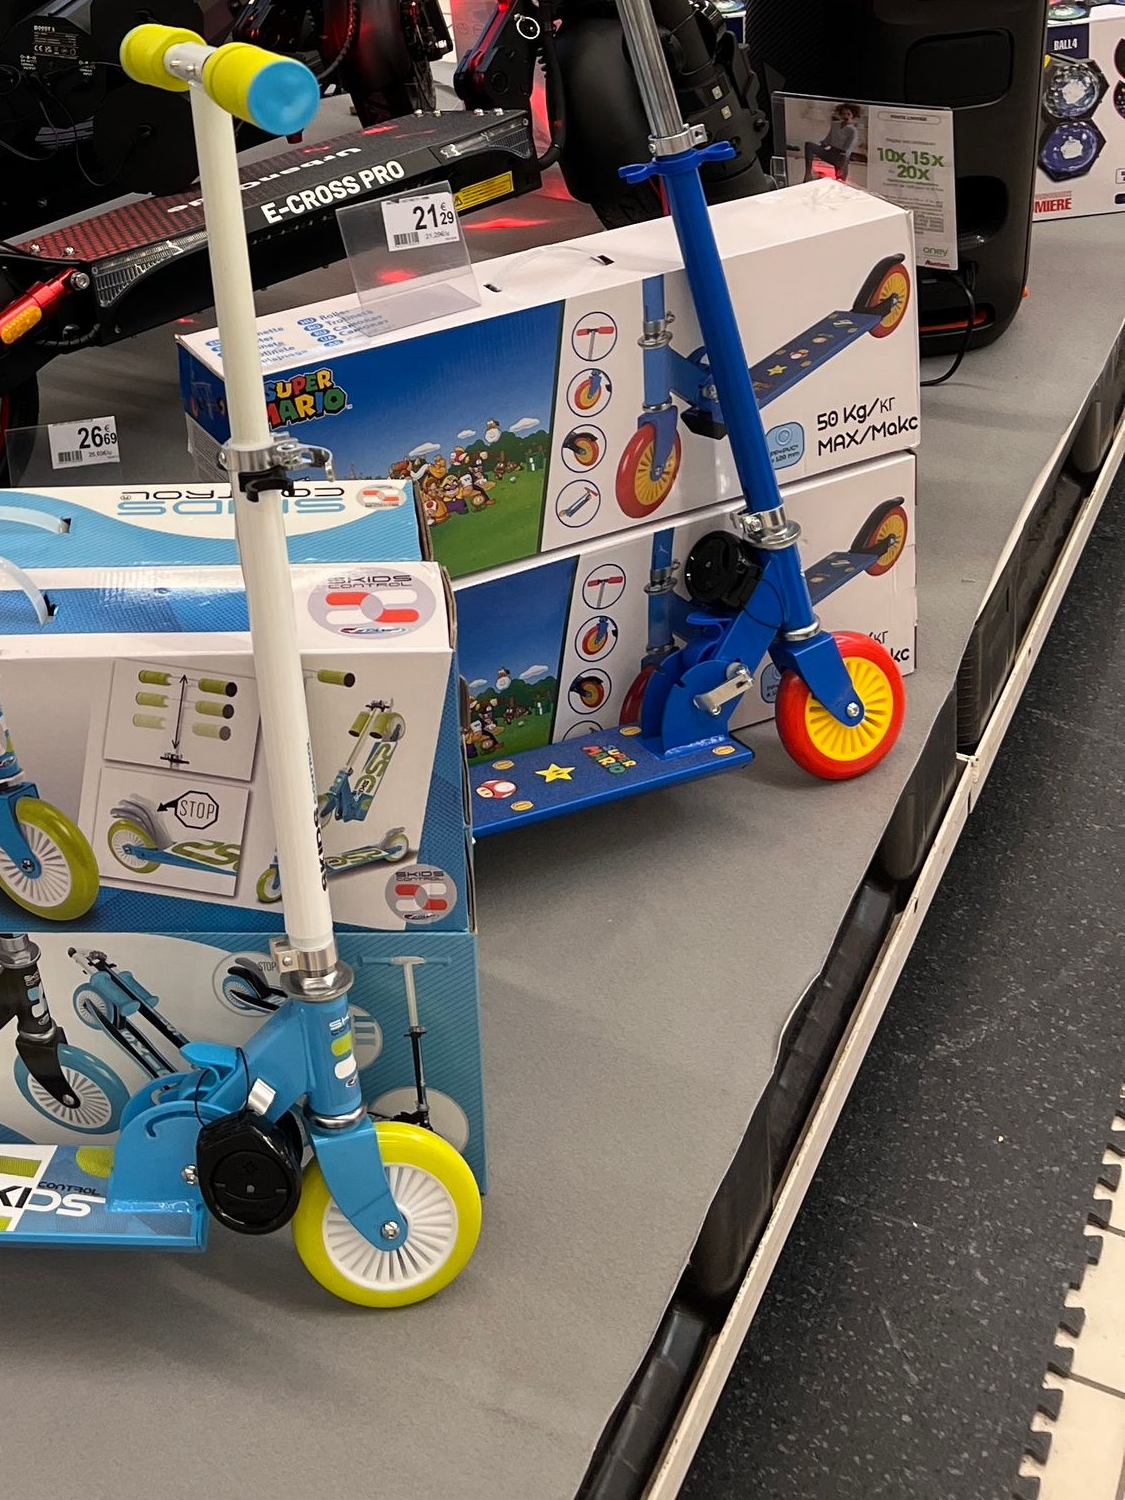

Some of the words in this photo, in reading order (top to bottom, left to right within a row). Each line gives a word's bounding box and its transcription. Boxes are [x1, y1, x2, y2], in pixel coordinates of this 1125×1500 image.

[1053, 38, 1078, 51] BALL4
[260, 175, 362, 224] E-CROSS
[358, 160, 405, 190] PRO
[264, 368, 334, 399] SUPER
[817, 410, 838, 432] 50
[179, 798, 216, 820] STOP
[258, 961, 276, 972] STOP
[37, 1180, 102, 1197] CONTROL
